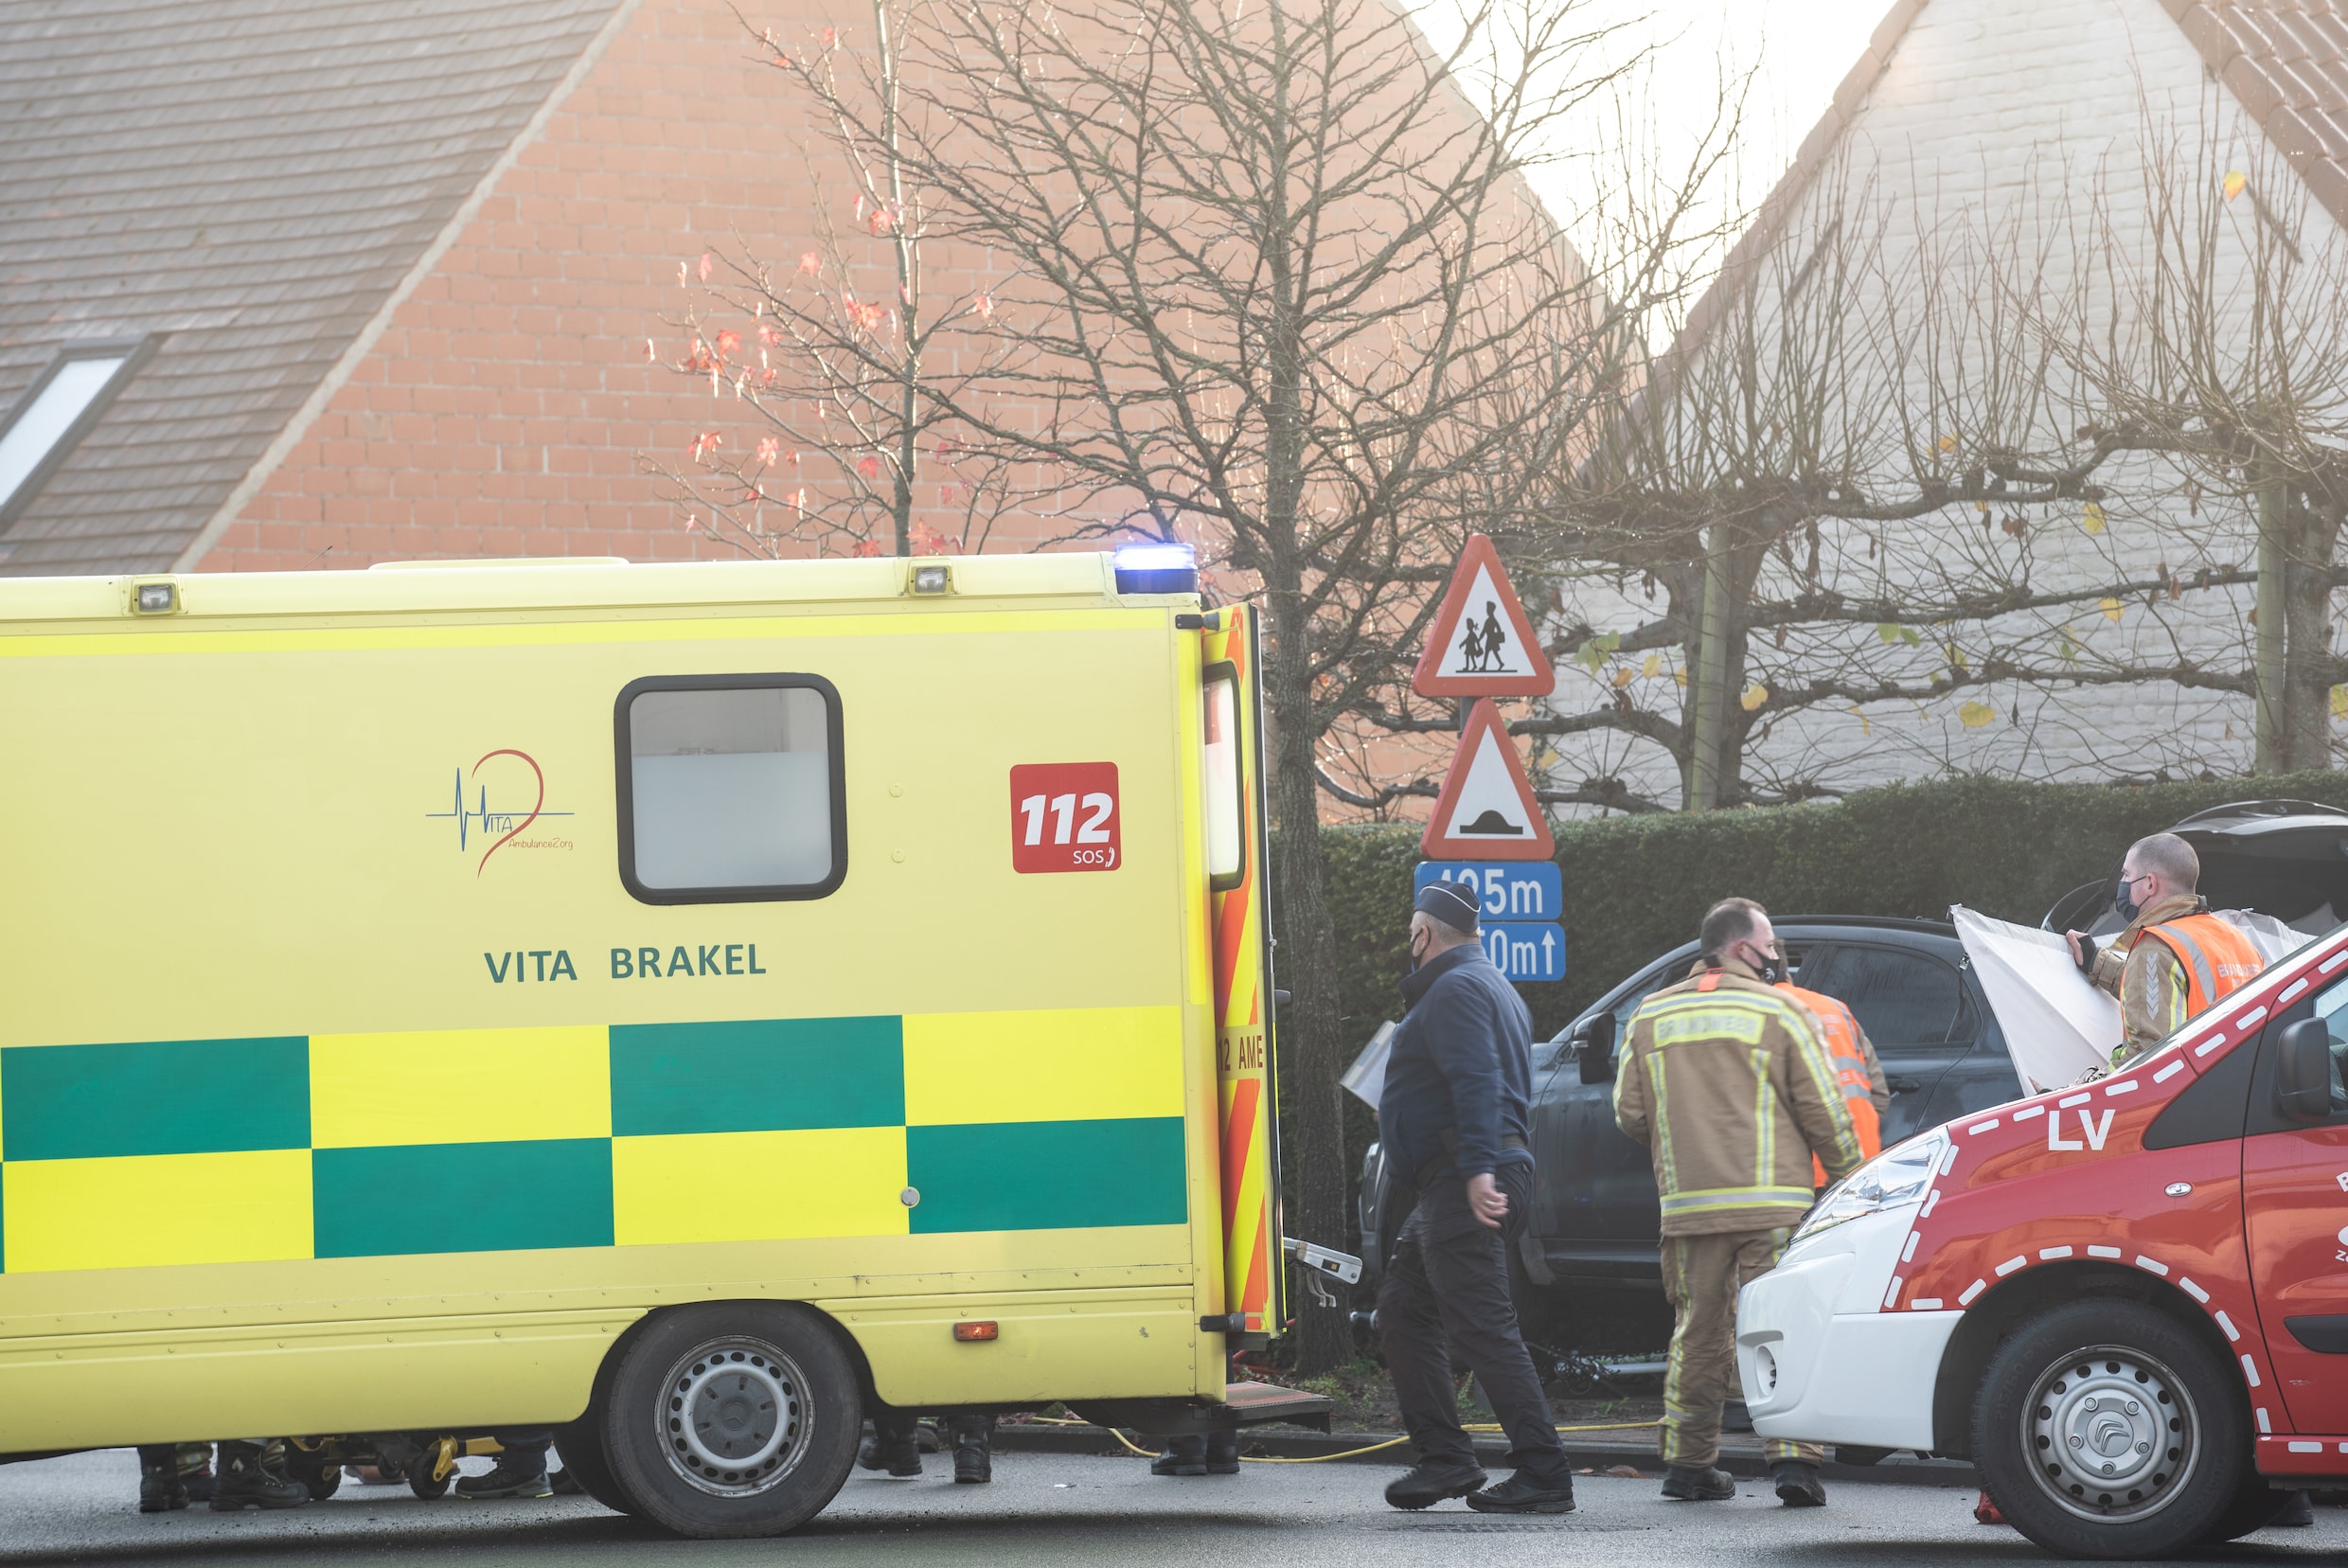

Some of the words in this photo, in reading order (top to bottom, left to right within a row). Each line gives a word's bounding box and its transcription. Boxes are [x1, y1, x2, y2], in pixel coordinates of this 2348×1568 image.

[1021, 793, 1113, 846] 112
[1073, 850, 1105, 864] SOS
[1440, 868, 1543, 915] 5m
[484, 950, 578, 983] VITA
[611, 943, 767, 979] BRAKEL
[2048, 1109, 2116, 1151] LV
